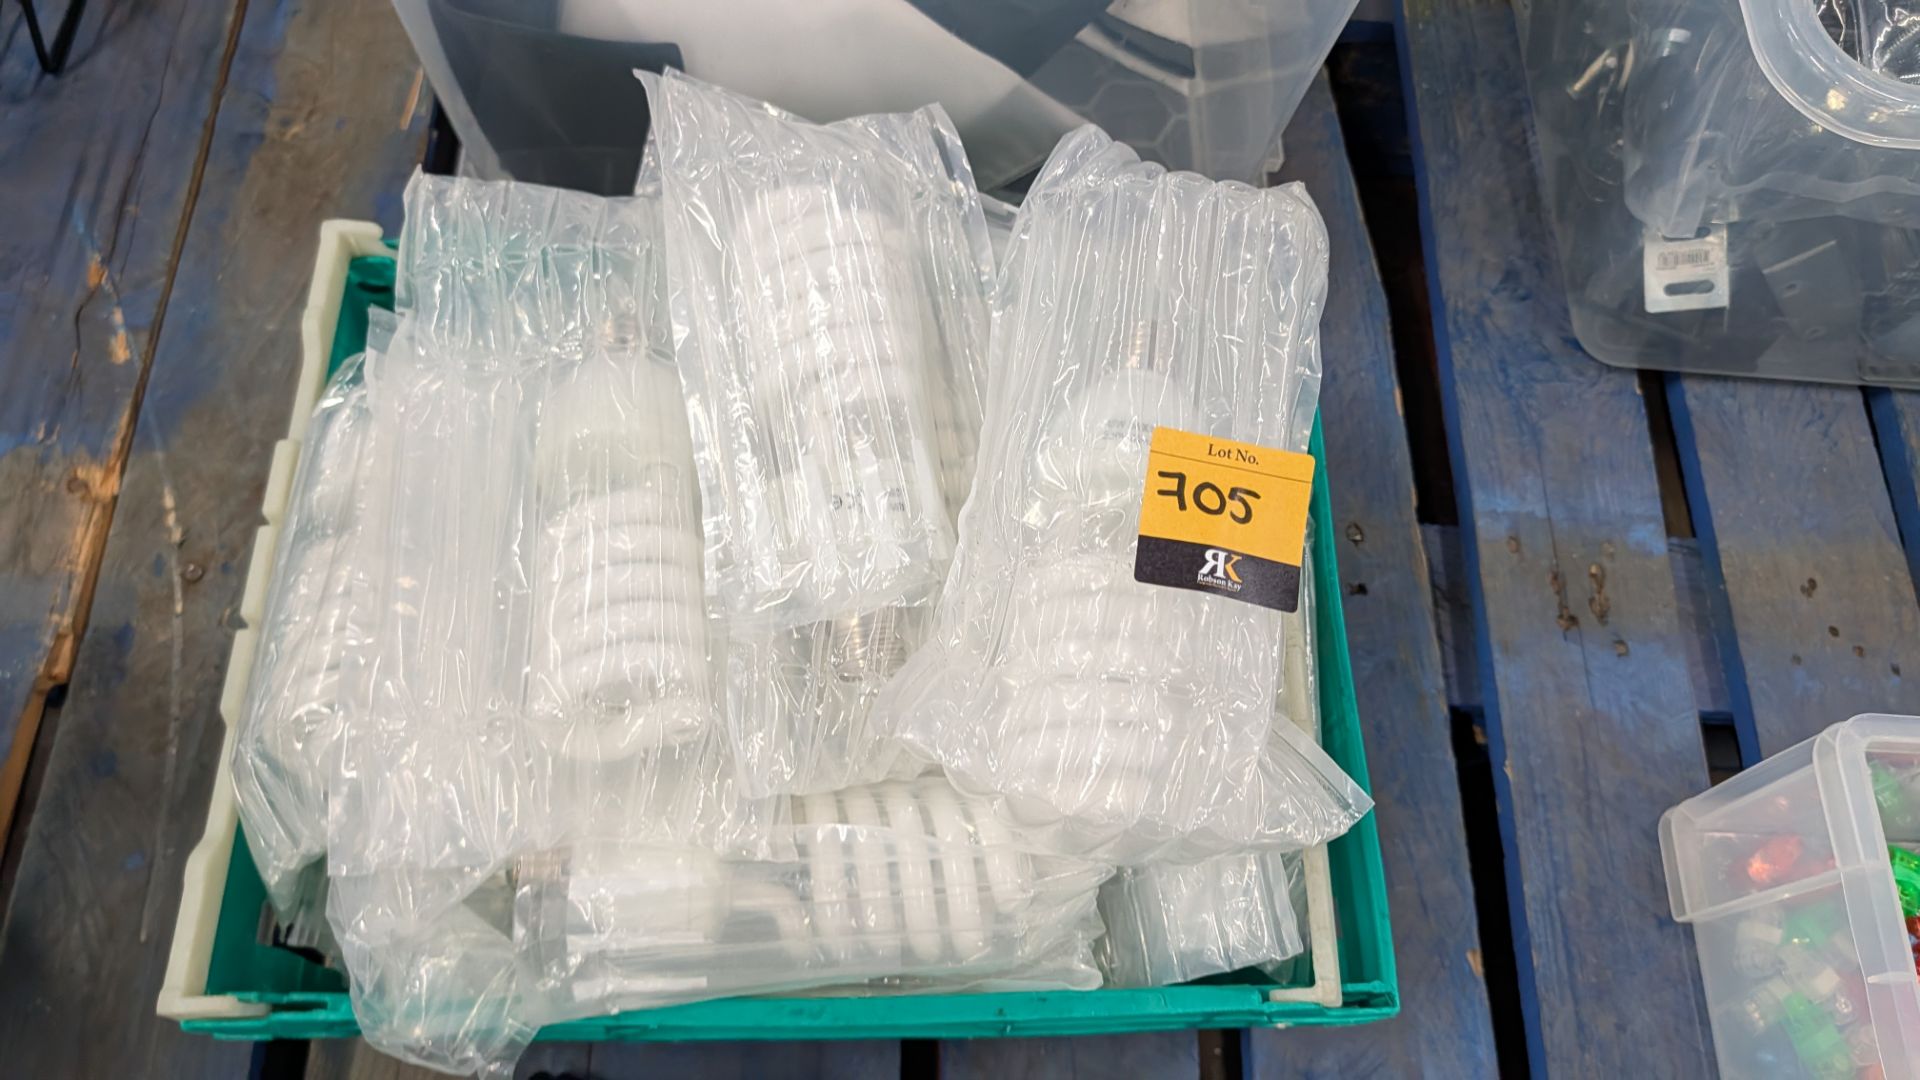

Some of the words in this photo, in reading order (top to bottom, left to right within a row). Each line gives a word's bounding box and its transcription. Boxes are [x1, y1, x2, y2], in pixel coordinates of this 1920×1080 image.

[1207, 443, 1232, 460] Lot
[1235, 448, 1259, 466] No.
[1157, 470, 1261, 525] 705
